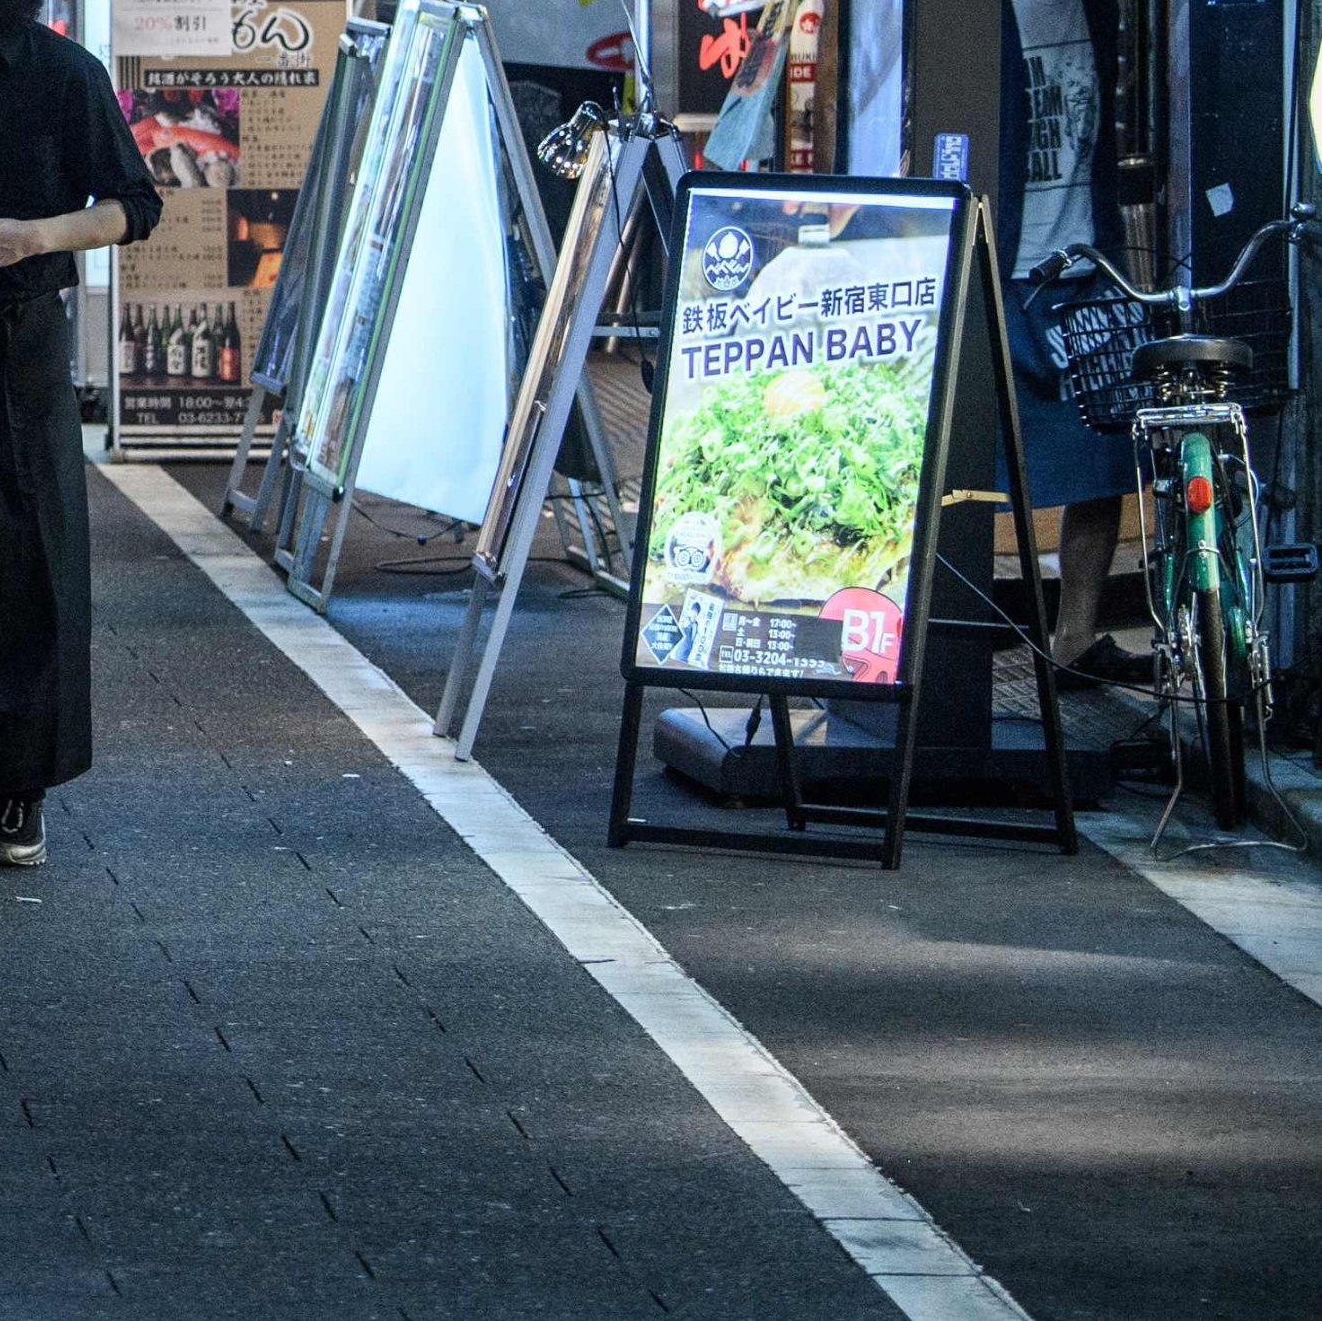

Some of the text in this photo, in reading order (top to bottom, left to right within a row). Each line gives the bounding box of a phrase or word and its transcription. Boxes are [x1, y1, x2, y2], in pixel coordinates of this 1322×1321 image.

[682, 276, 937, 335] 鉄板ベイビー新宿東口店
[681, 318, 923, 380] TEPPAN BABY
[736, 629, 745, 638] 土
